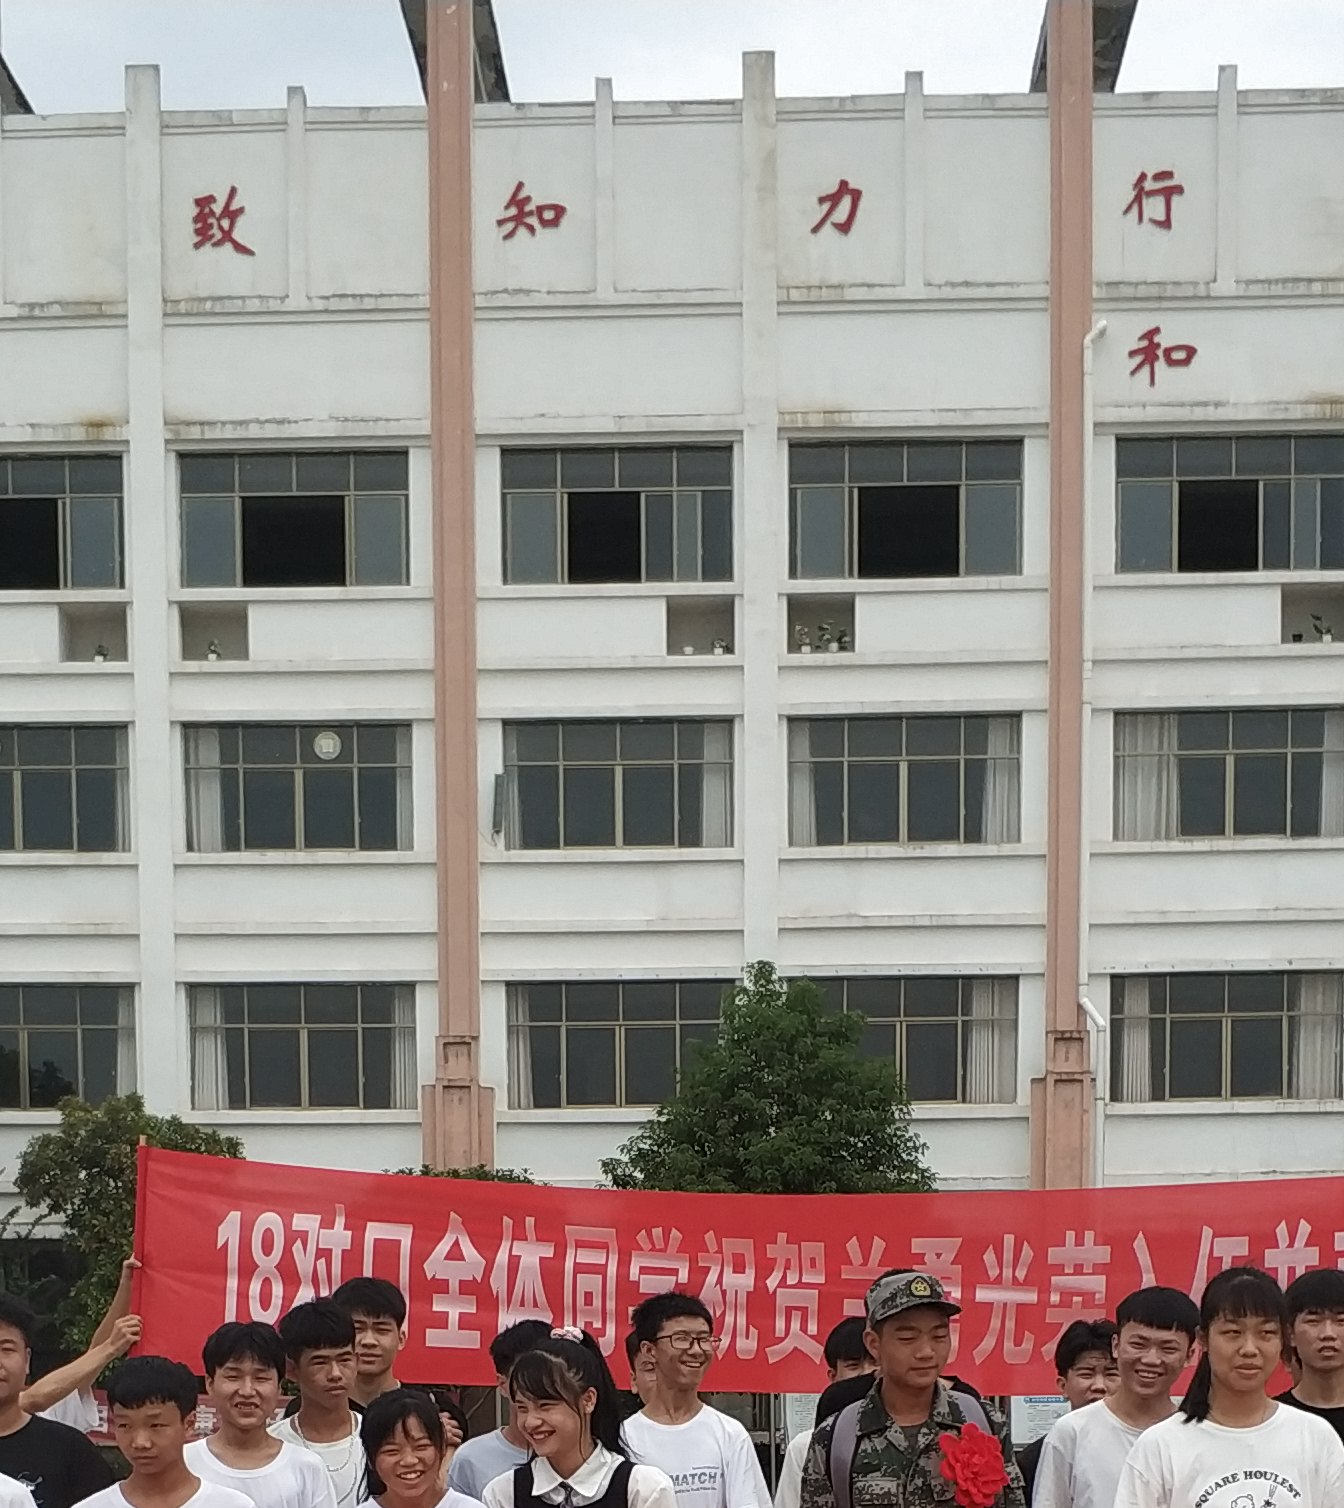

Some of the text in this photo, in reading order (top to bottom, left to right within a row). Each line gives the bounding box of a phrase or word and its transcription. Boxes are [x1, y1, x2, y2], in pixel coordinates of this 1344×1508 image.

[191, 170, 1185, 257] 致知力行
[1242, 1470, 1302, 1500] HOULEST
